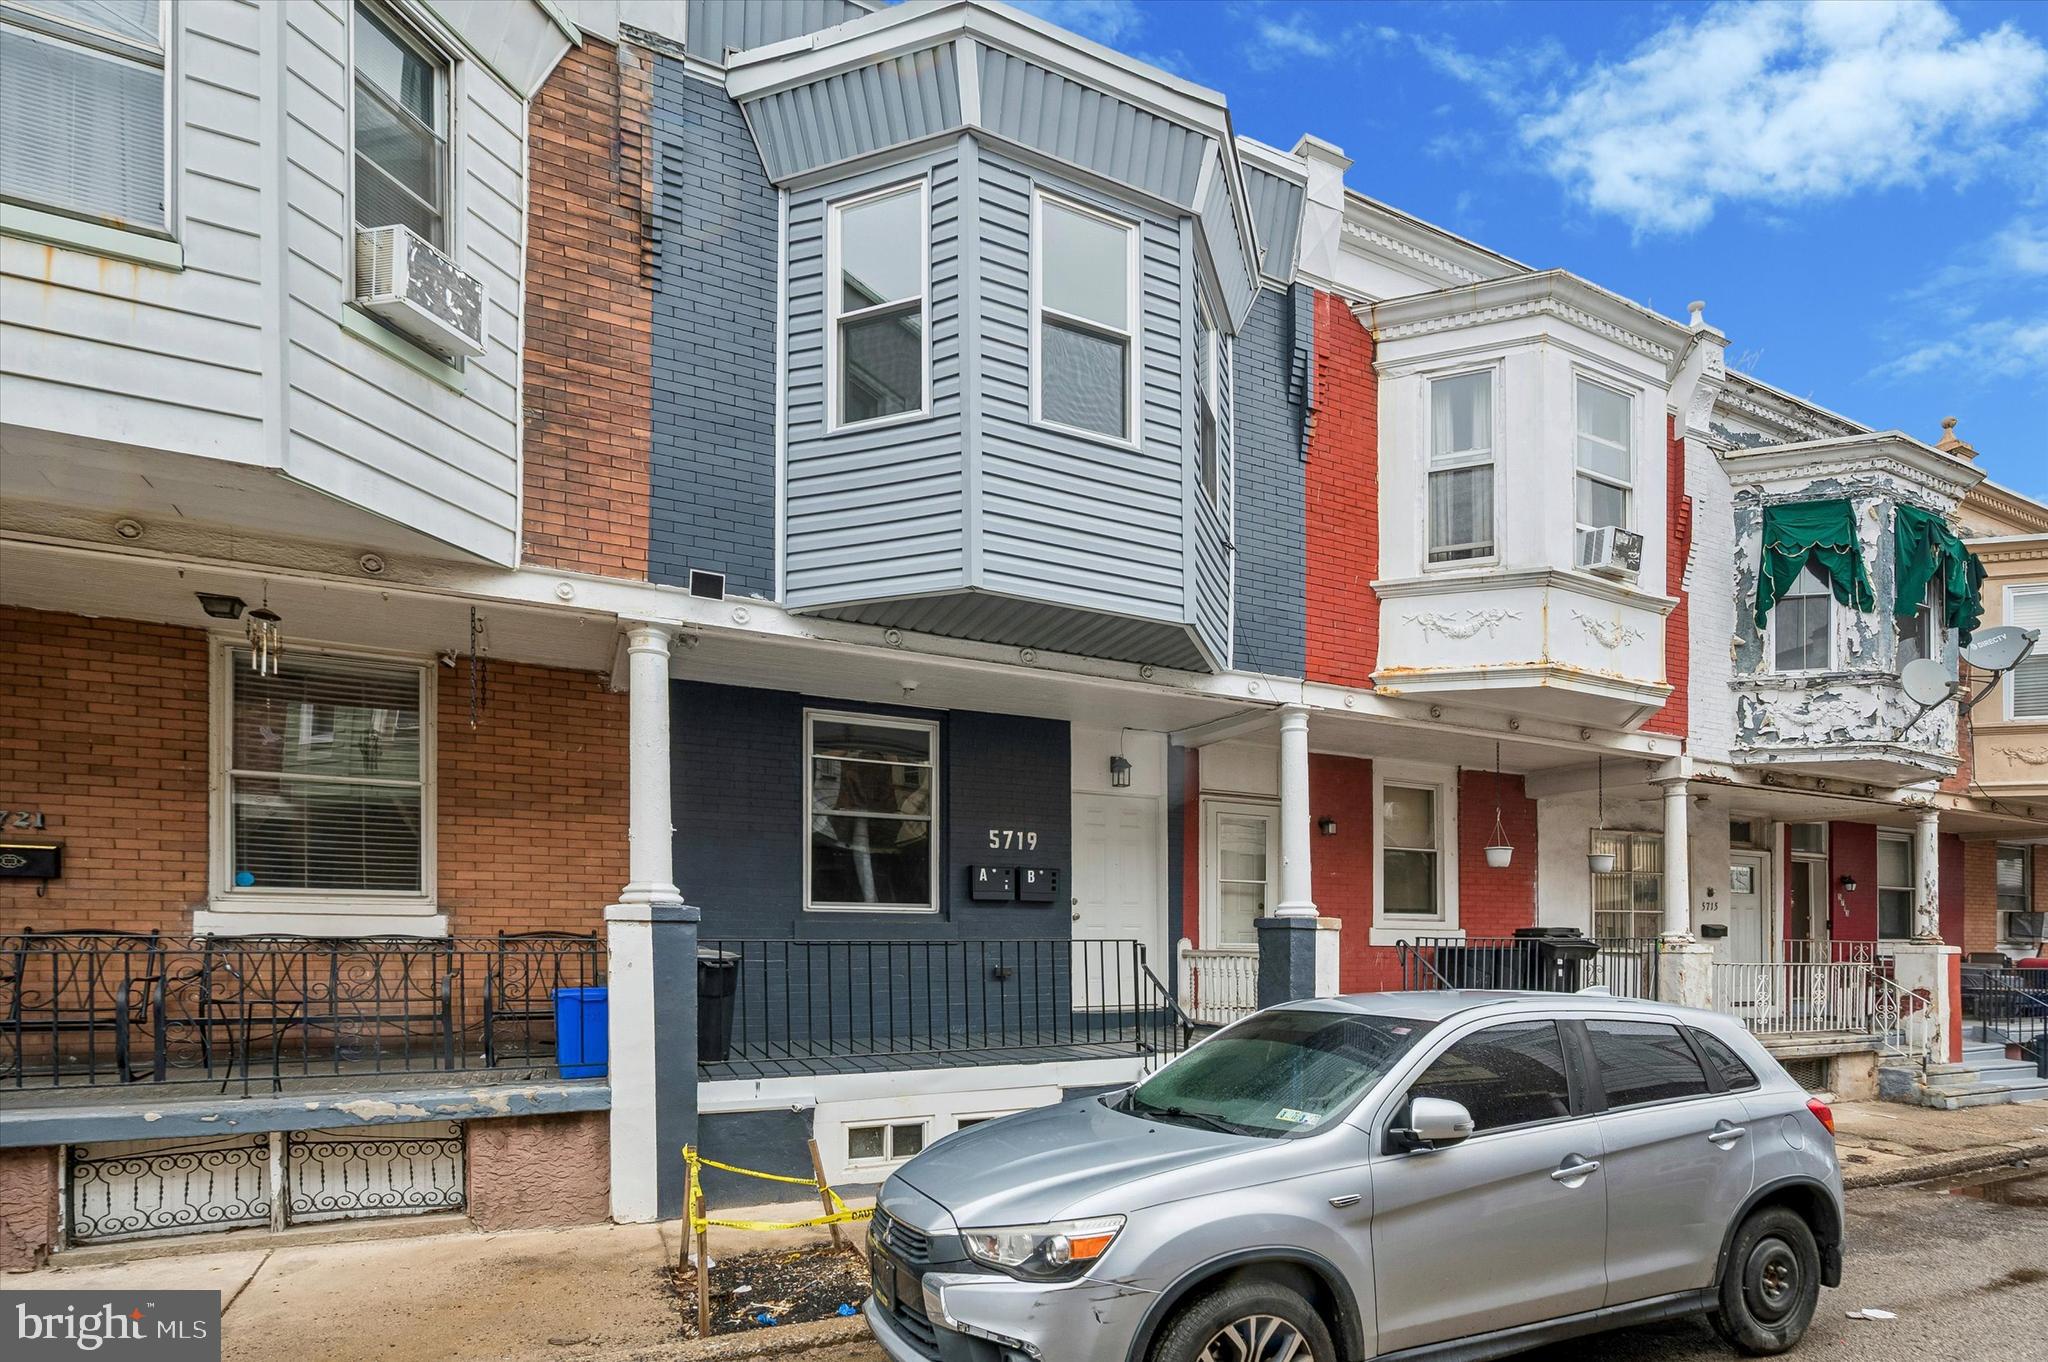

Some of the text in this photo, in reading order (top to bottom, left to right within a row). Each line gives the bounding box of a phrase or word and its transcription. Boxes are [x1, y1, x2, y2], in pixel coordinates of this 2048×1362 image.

[1977, 633, 2007, 648] DIRECTV
[989, 829, 1038, 850] 5719
[979, 868, 988, 881] A
[1027, 870, 1036, 883] B
[1702, 902, 1719, 911] 5715
